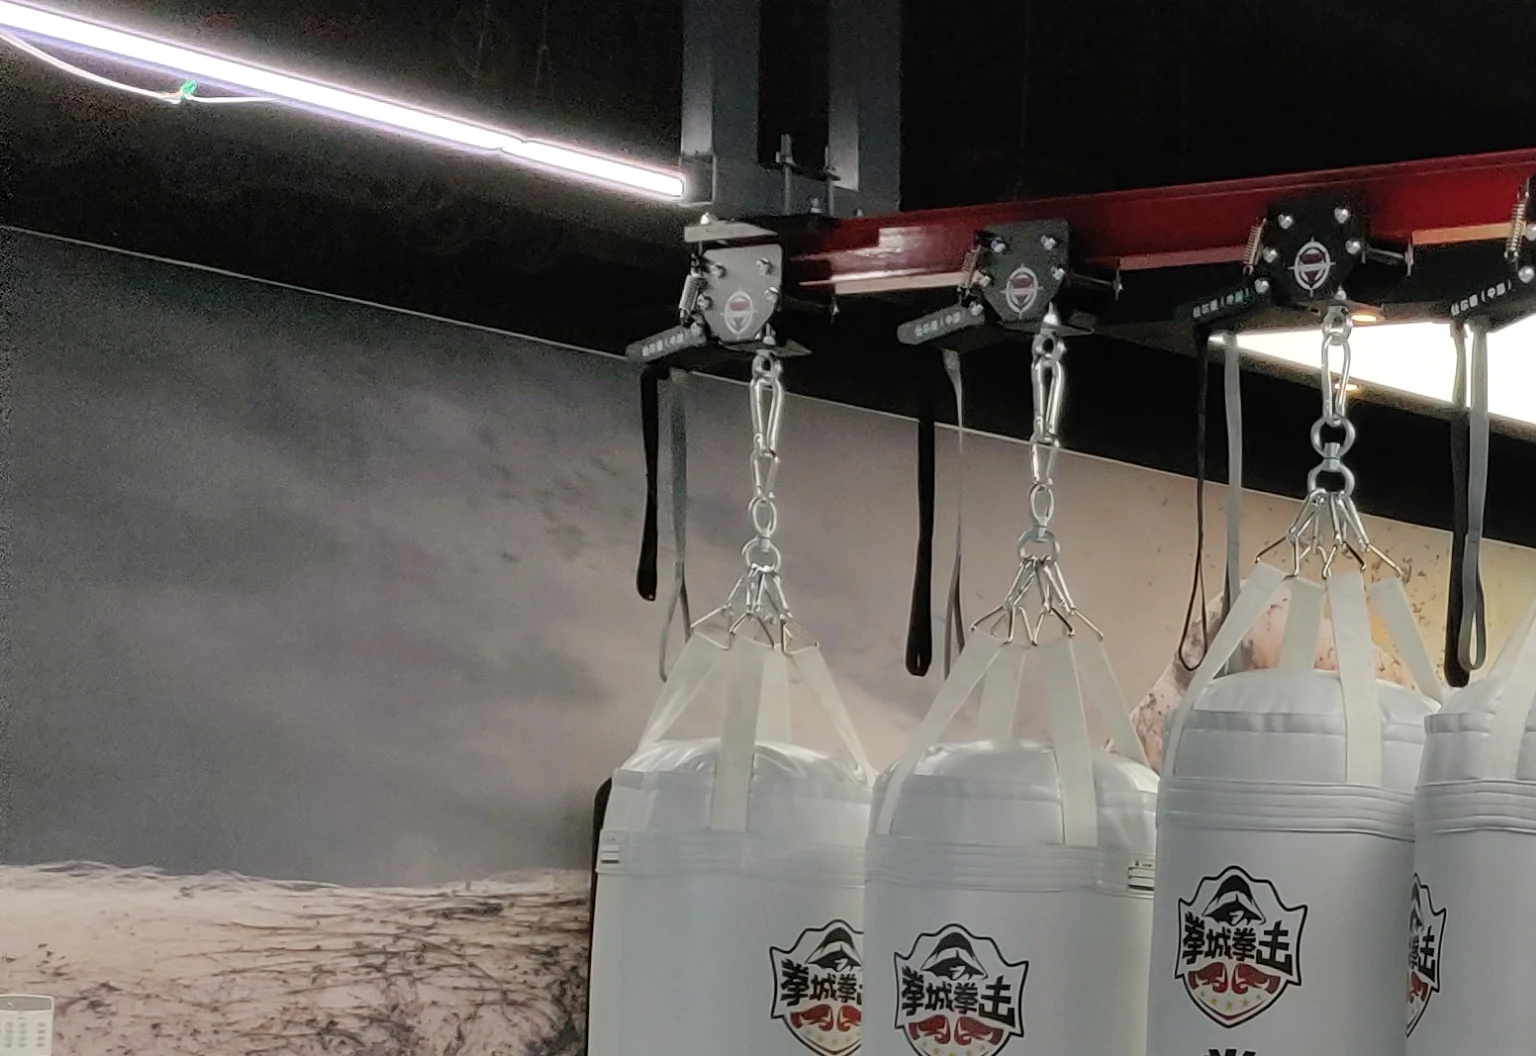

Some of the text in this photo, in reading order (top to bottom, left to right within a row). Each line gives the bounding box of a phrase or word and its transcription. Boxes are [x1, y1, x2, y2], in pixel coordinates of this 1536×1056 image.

[1181, 911, 1294, 976] 拳城拳击
[779, 957, 862, 1008] 拳城拳
[901, 966, 1016, 1026] 拳城拳击
